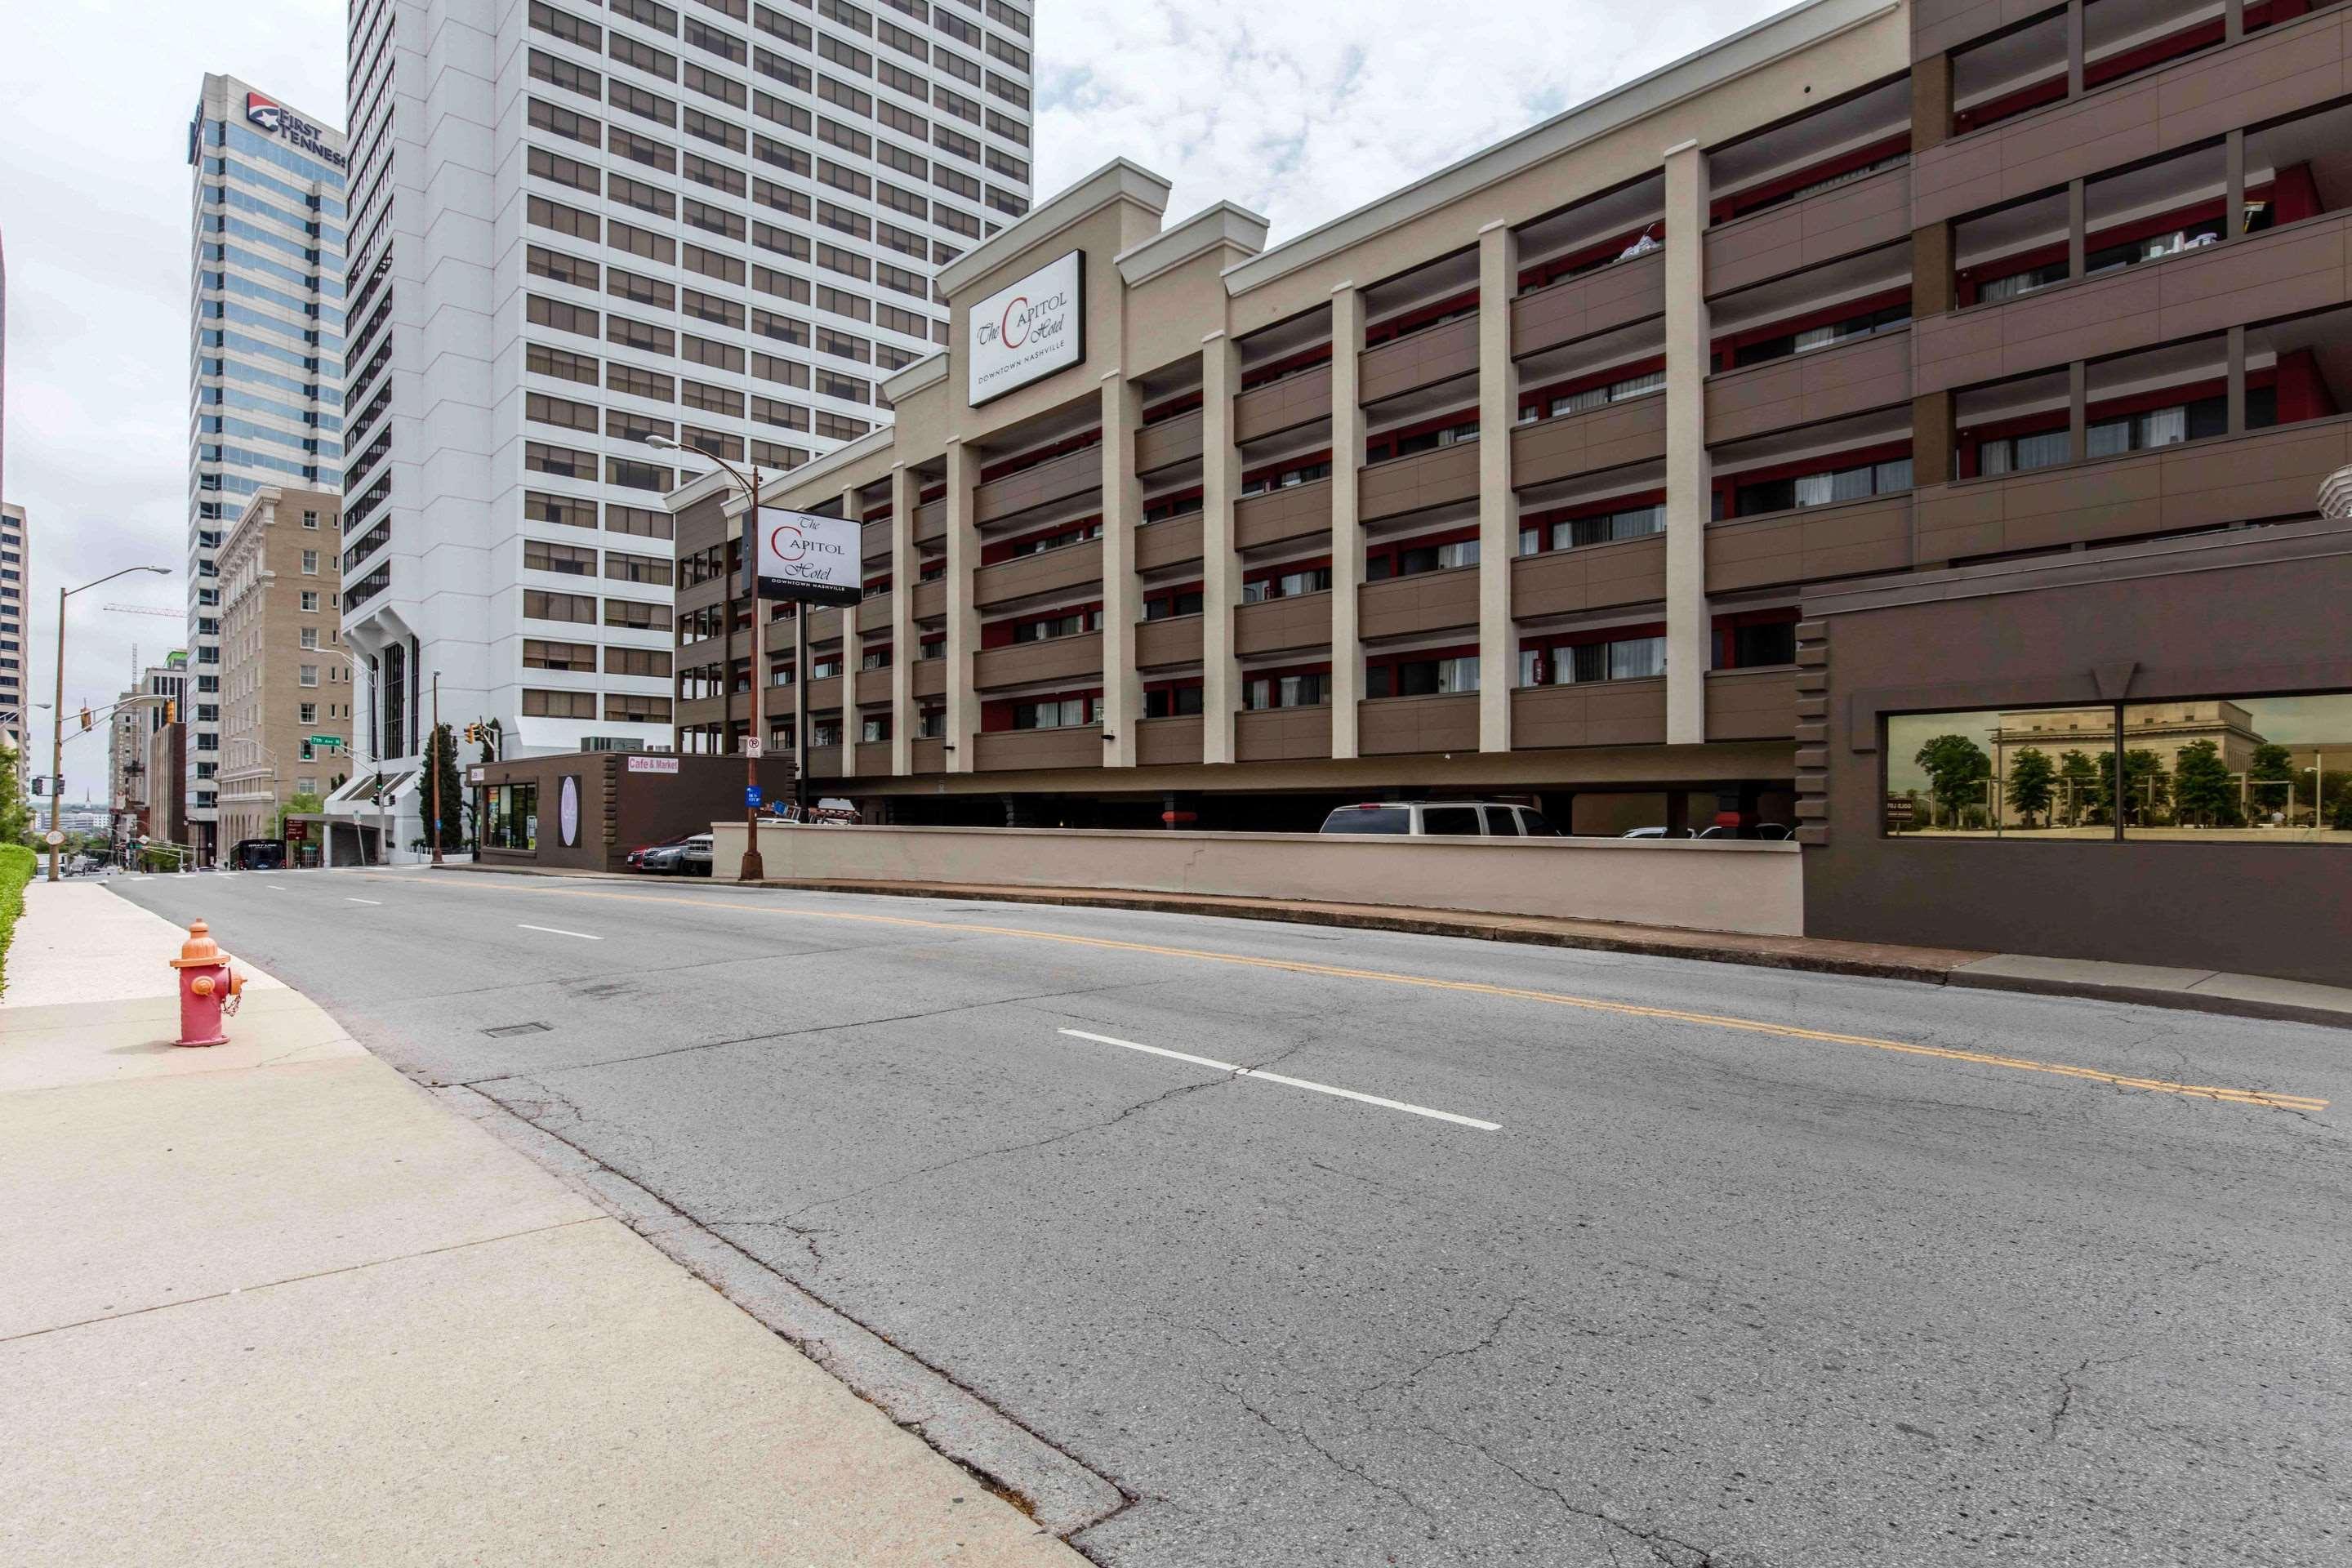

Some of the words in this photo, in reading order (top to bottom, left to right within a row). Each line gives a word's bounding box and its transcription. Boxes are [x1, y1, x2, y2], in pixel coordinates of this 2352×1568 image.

[278, 108, 322, 140] FIRST
[978, 319, 1000, 345] The
[1001, 292, 1067, 349] CAPITOL
[1030, 314, 1065, 344] Hotel
[978, 362, 1021, 384] DOWNTOWN
[1024, 340, 1065, 362] NASHVILLE
[797, 516, 822, 530] The
[771, 526, 845, 561] CAPITOL
[771, 578, 811, 587] DOWNTOWN
[813, 583, 846, 591] NASHVILLE
[784, 563, 831, 581] Hotel
[629, 758, 648, 769] Cafe
[649, 759, 654, 768] &
[656, 759, 678, 770] Market
